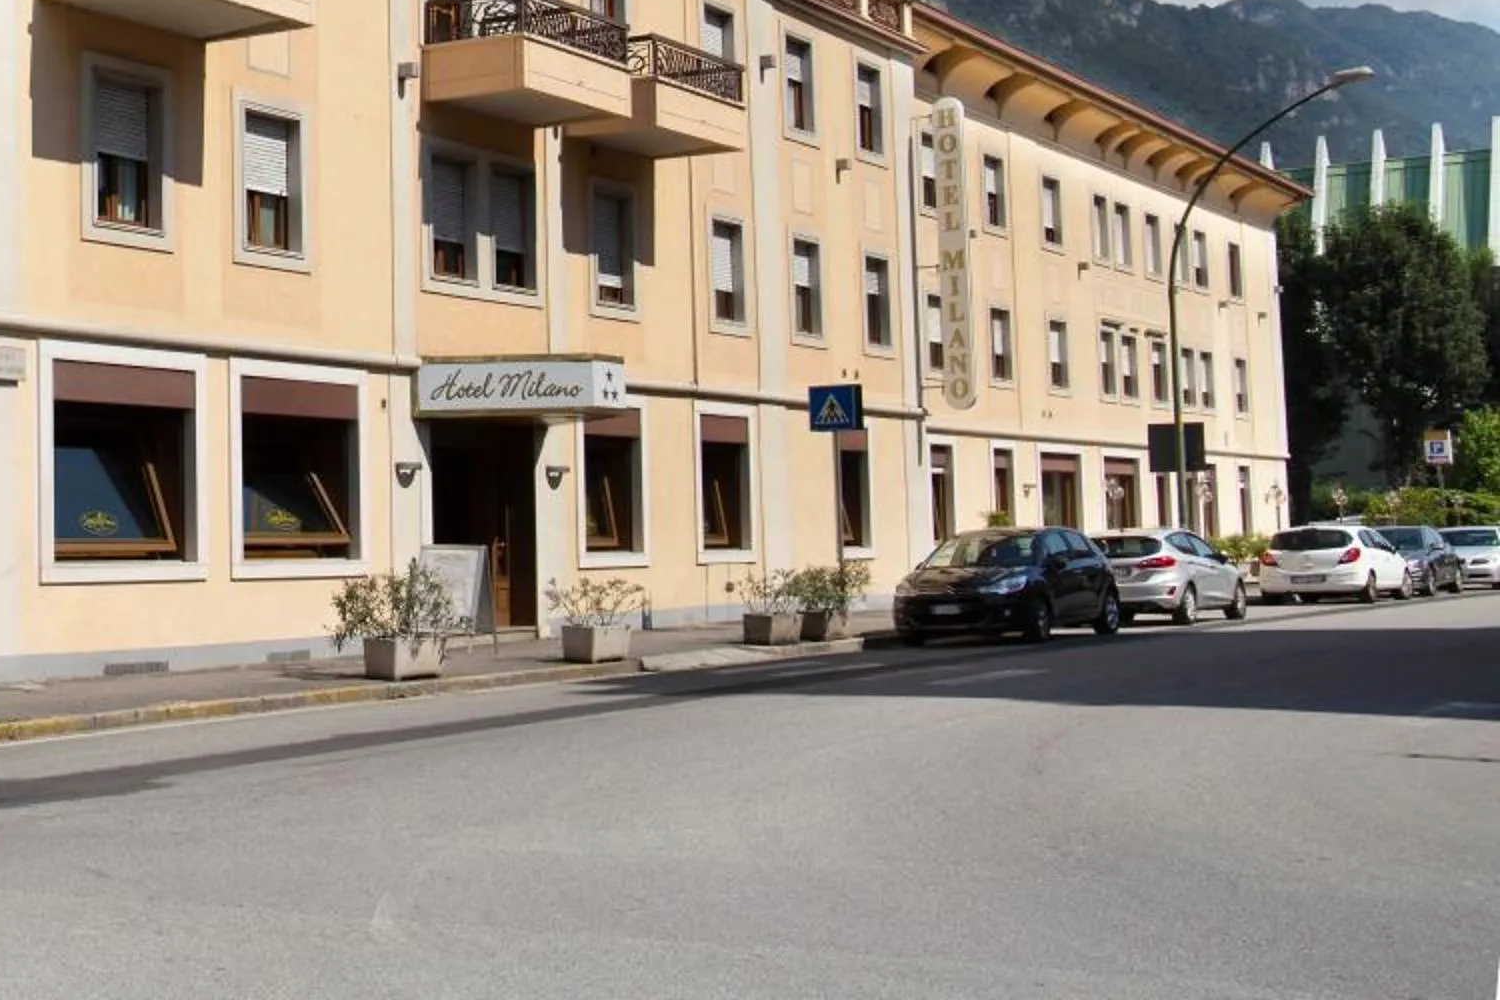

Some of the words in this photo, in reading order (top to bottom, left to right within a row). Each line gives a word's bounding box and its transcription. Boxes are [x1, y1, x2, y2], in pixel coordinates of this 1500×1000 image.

[937, 107, 960, 233] HOTEL
[430, 367, 494, 401] Hotel
[498, 369, 583, 401] Milano
[941, 250, 970, 400] MILANO
